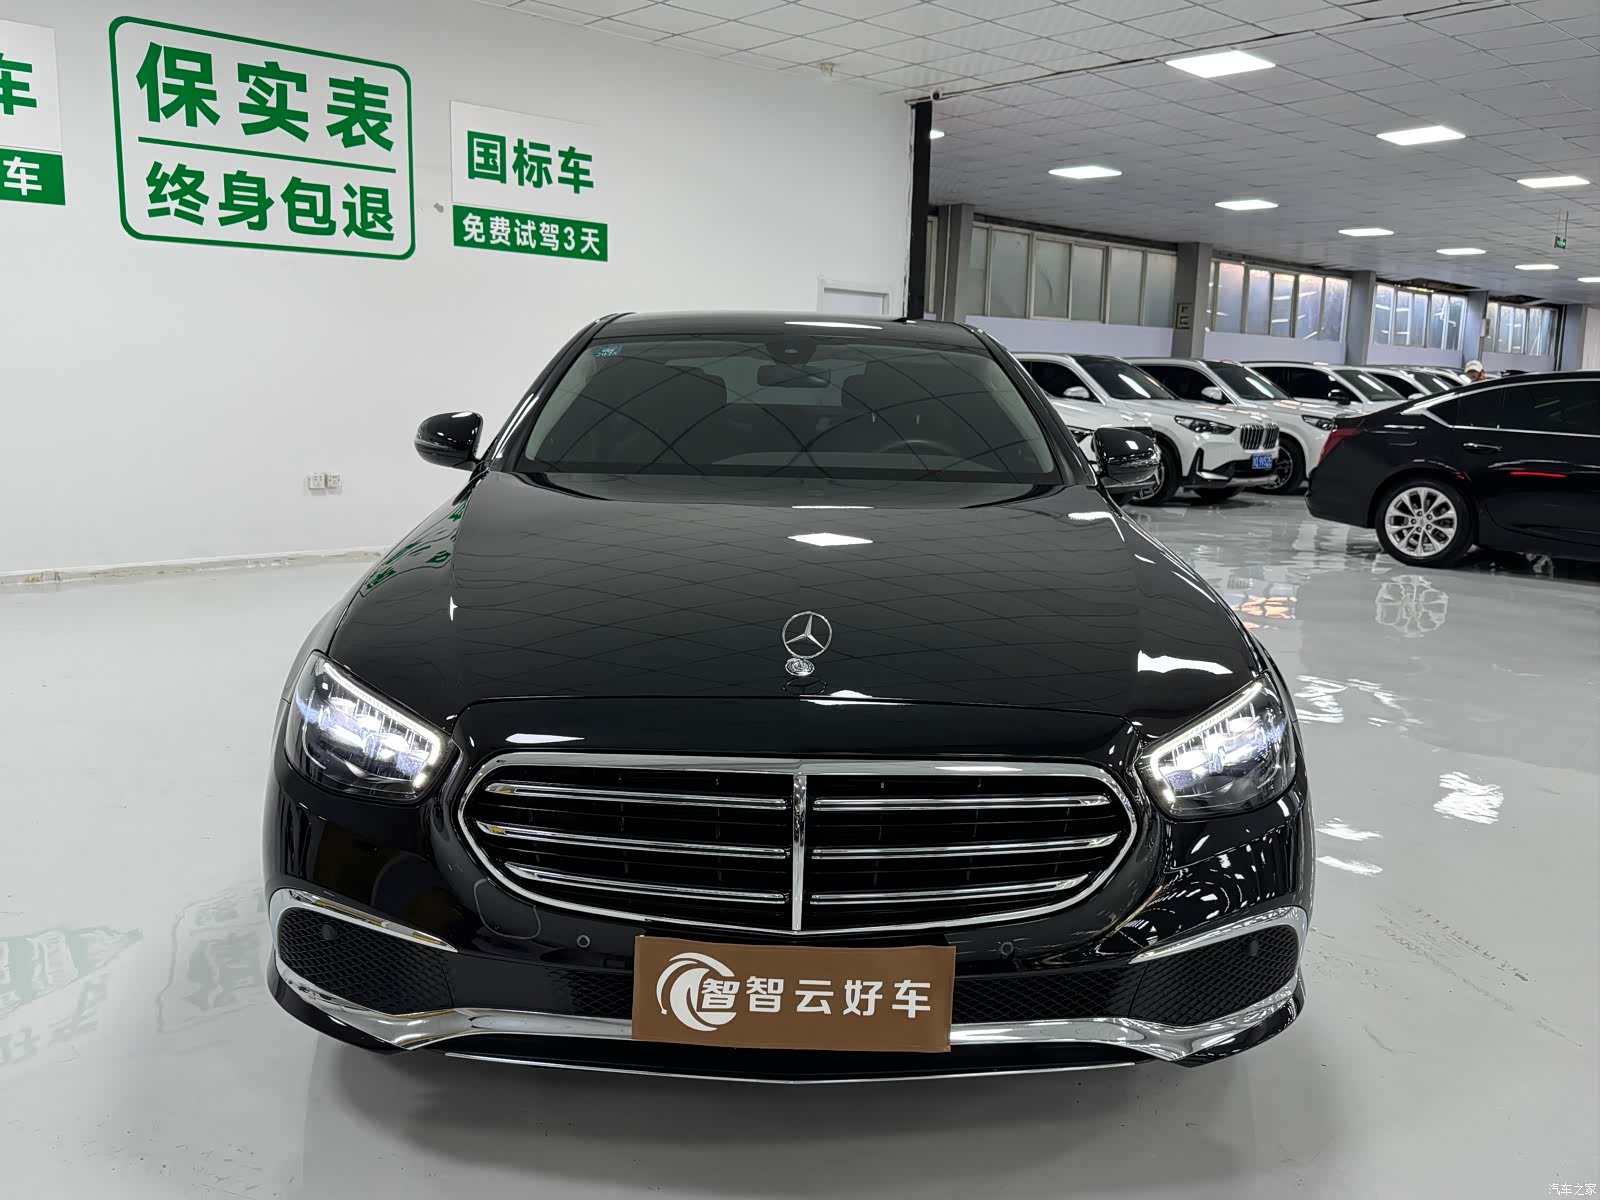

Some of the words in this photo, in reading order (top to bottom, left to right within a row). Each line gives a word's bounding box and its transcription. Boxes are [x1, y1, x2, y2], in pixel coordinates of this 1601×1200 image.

[137, 43, 395, 151] 保实表
[467, 131, 594, 194] 国标车
[146, 162, 394, 242] 终身包退
[462, 212, 600, 256] 免费试驾3天
